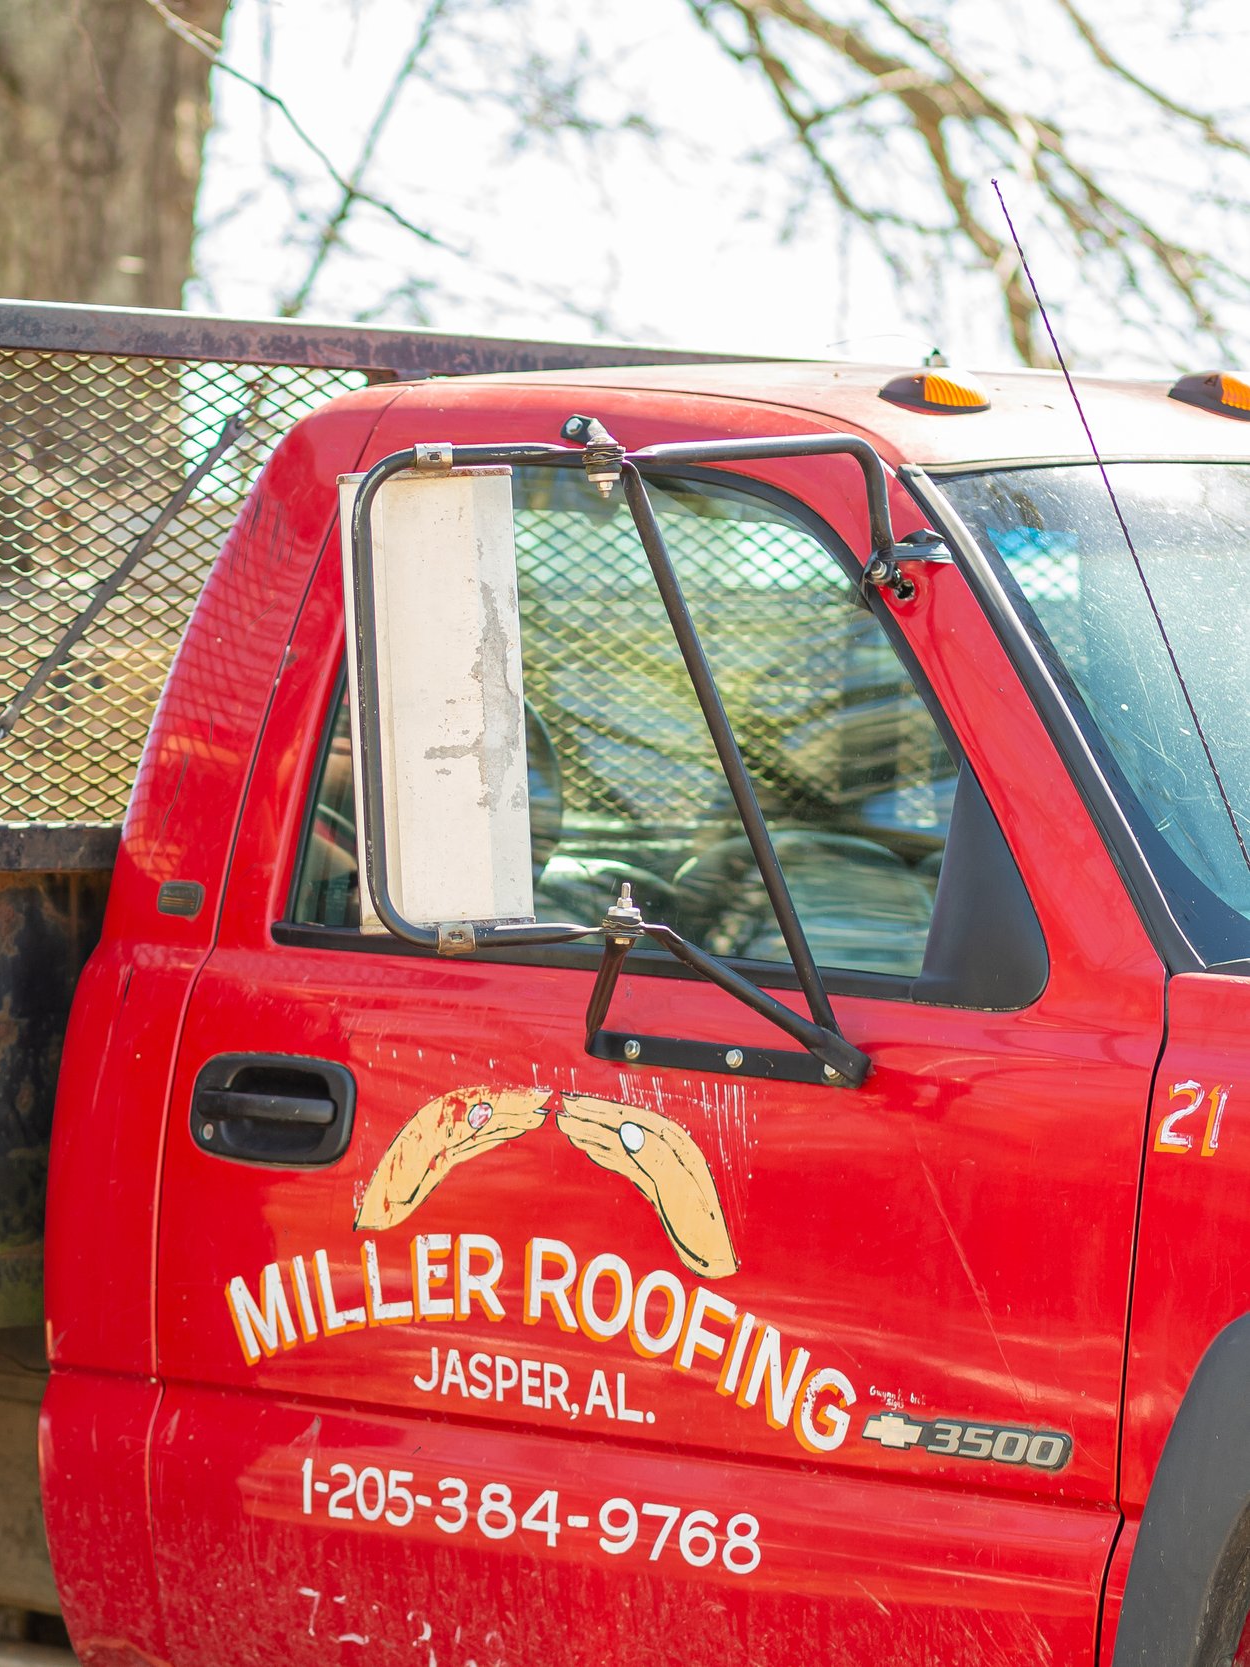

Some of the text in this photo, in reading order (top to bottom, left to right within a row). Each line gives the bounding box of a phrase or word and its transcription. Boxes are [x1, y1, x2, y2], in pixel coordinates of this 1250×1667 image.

[1154, 1080, 1230, 1156] 21
[225, 1233, 857, 1454] MILLER ROOFING
[414, 1347, 656, 1424] JASPER, AL.
[927, 1423, 1064, 1466] 3500
[302, 1458, 762, 1574] 1-205-384-9768
